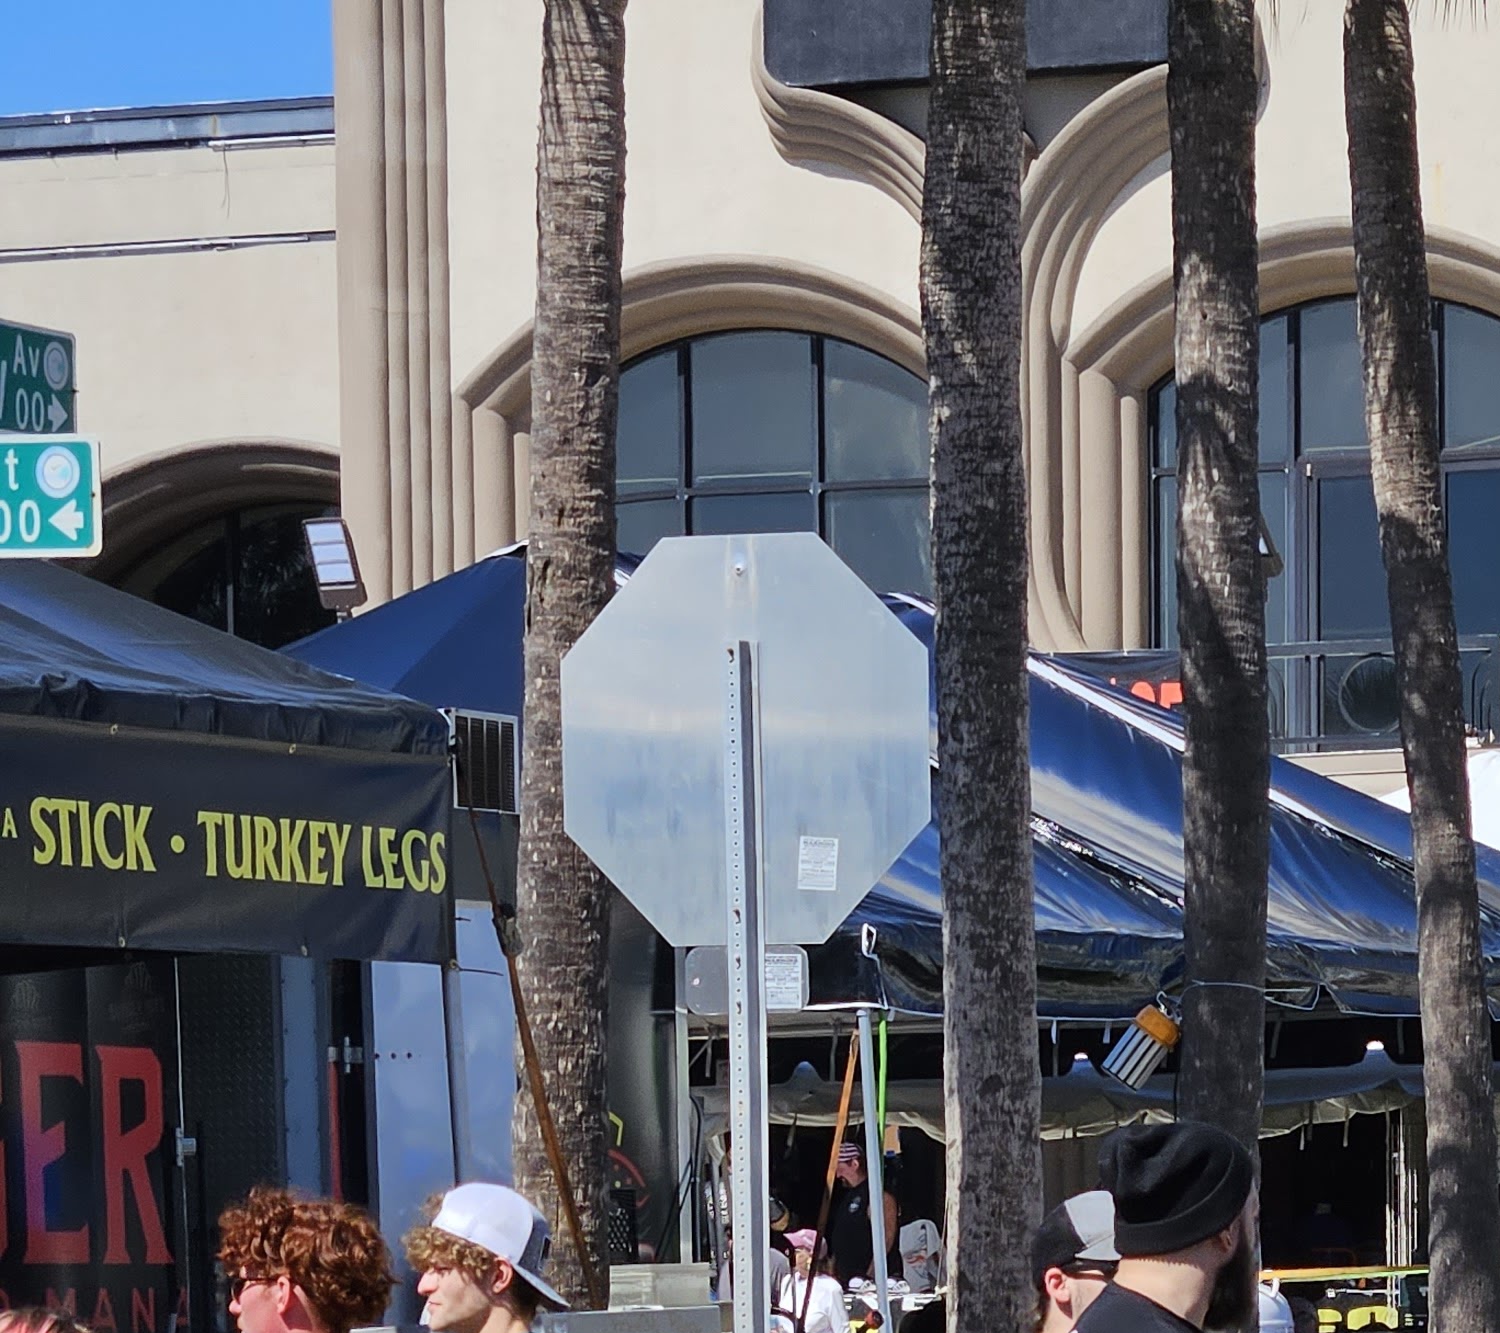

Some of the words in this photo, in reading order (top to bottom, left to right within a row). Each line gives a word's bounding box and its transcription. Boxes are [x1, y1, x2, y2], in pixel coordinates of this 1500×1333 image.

[13, 333, 40, 378] Av
[2, 807, 18, 838] A
[30, 796, 157, 872] STICK
[197, 810, 352, 886] TURKEY
[362, 825, 447, 895] LEGS
[0, 1040, 175, 1264] ER
